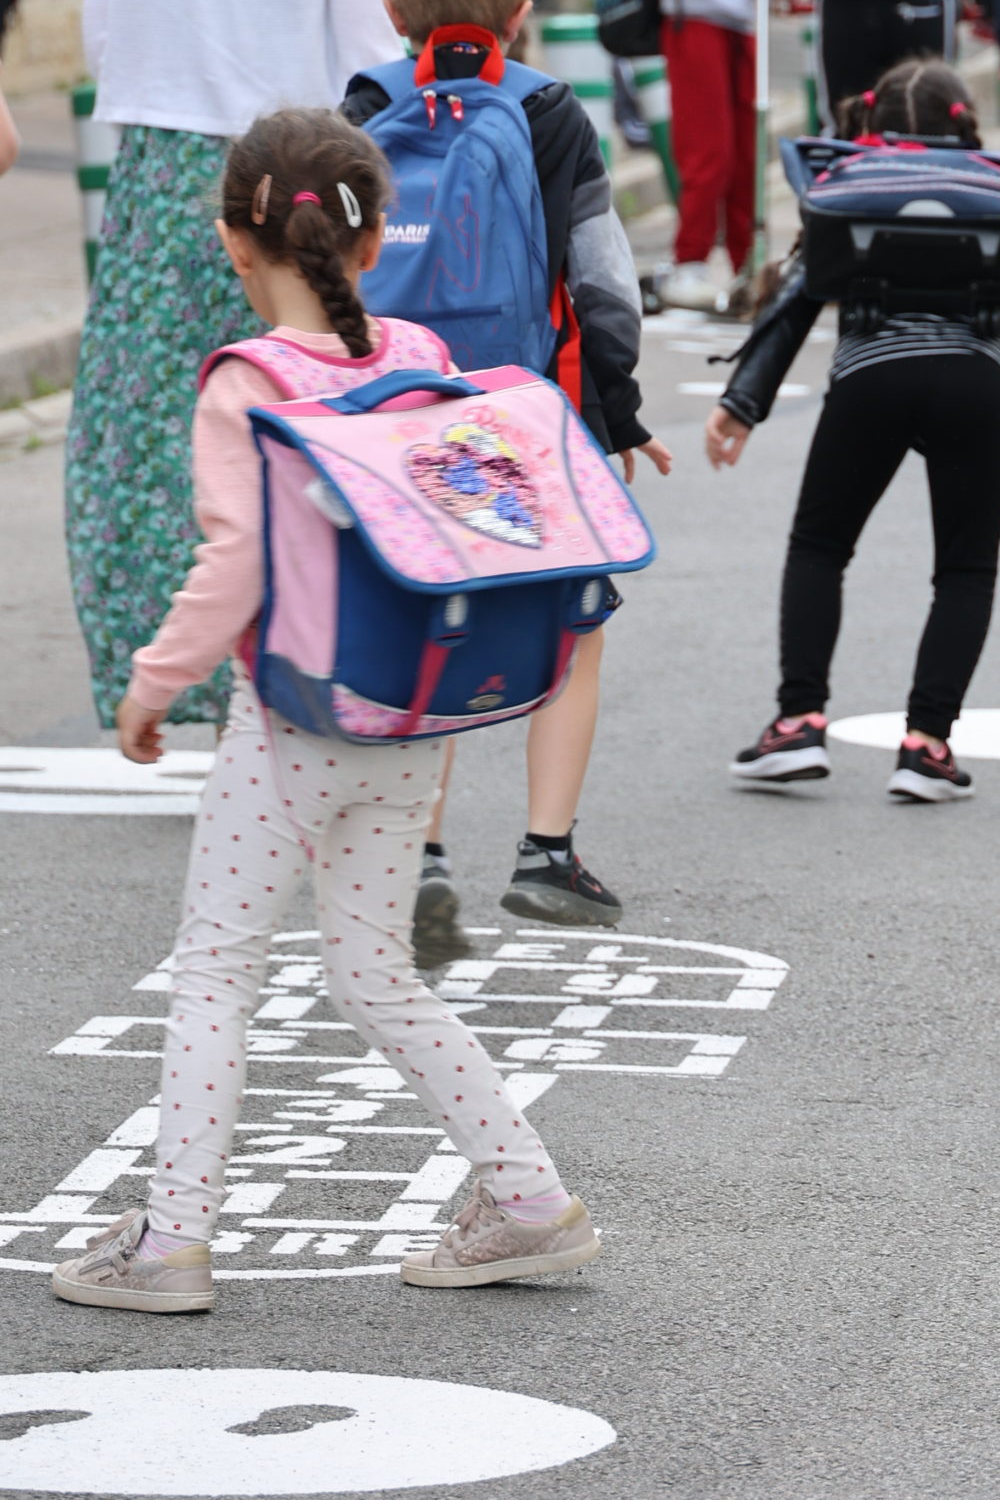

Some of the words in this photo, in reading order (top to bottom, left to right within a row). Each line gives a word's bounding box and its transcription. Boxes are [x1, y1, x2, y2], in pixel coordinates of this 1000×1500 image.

[383, 223, 431, 237] PARIS
[493, 943, 649, 963] EL
[503, 1038, 607, 1061] 6
[273, 1099, 386, 1122] 3
[227, 1135, 348, 1165] 2
